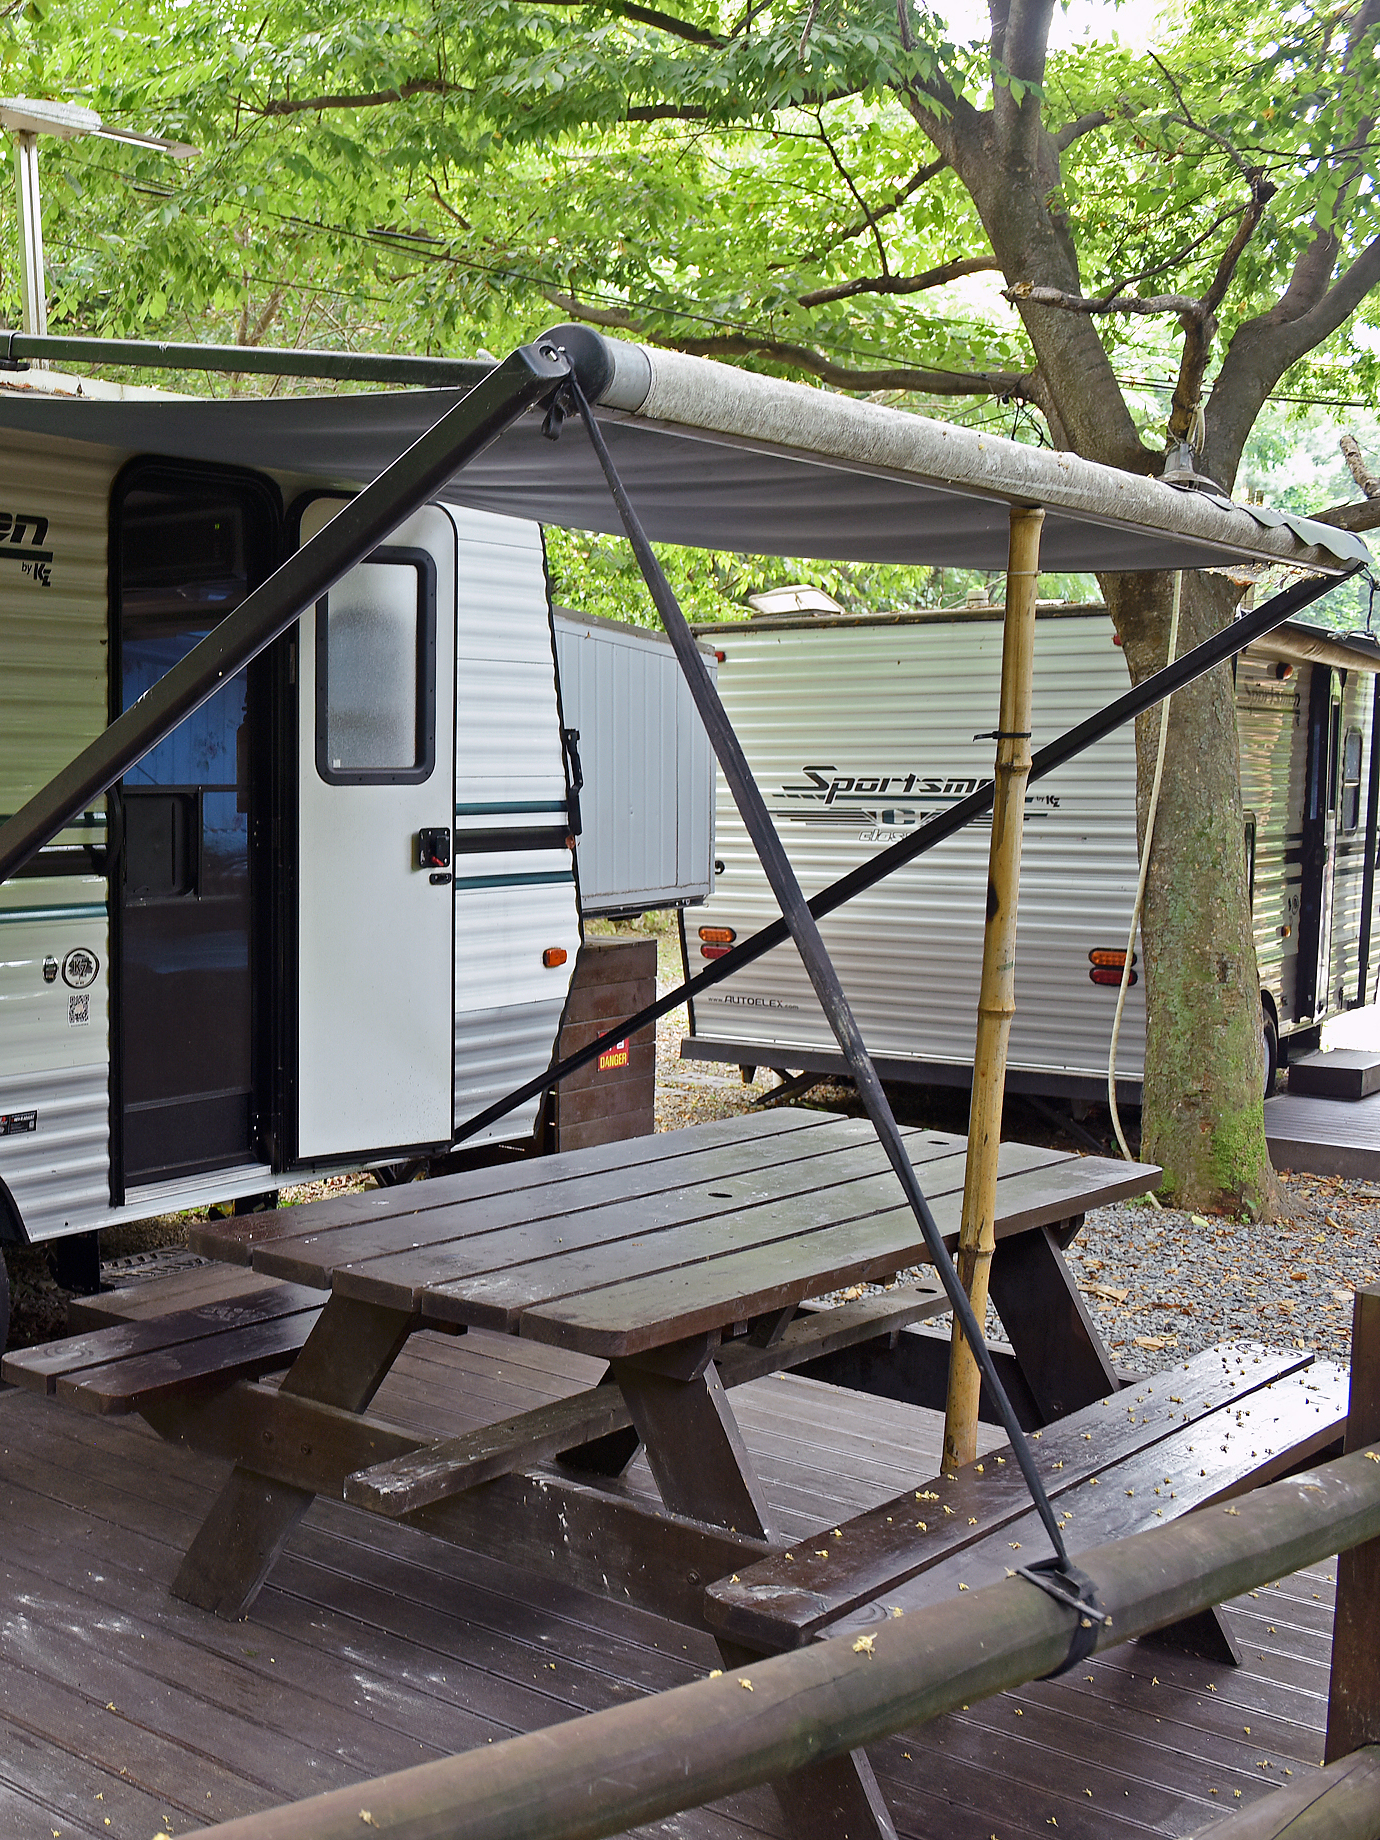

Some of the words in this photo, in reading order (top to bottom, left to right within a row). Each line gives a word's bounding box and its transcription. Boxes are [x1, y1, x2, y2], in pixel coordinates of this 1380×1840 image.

[22, 561, 32, 575] by
[781, 765, 994, 804] Sportsm
[859, 829, 911, 841] clas
[600, 1052, 627, 1069] DANGER
